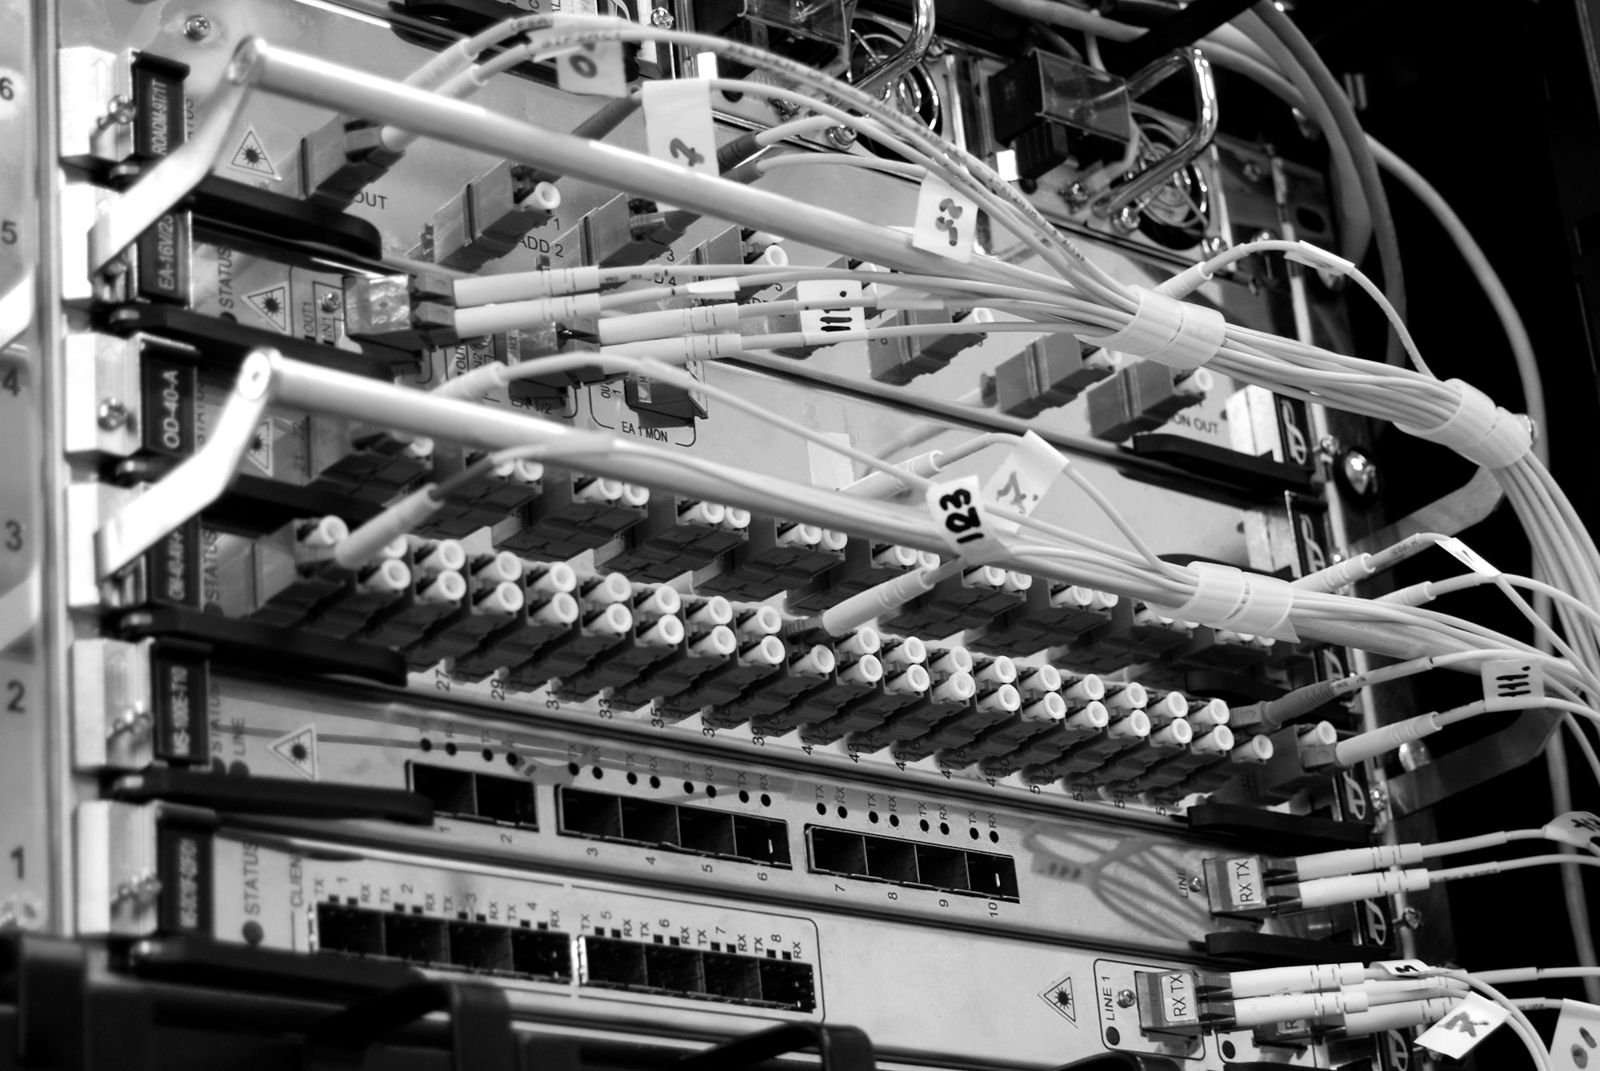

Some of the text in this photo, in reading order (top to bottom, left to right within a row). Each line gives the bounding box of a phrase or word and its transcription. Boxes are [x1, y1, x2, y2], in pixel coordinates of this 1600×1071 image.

[2, 220, 18, 245] 5
[553, 218, 560, 231] 1
[554, 243, 564, 258] 2
[217, 246, 234, 309] STATUS
[2, 367, 21, 397] 4
[163, 369, 180, 449] OD-40-A
[622, 421, 637, 435] EA
[645, 428, 669, 443] MON
[939, 487, 984, 545] 123
[5, 520, 23, 551] 3
[435, 669, 450, 692] 27
[7, 680, 26, 714] 2
[490, 679, 506, 701] 29
[546, 690, 560, 711] 31
[598, 698, 613, 720] 33
[651, 707, 665, 729] 35
[701, 716, 716, 738] 37
[752, 725, 765, 747] 39
[737, 770, 748, 786] TX
[760, 774, 769, 791] RX
[815, 784, 825, 801] TX
[836, 786, 846, 804] RX
[867, 793, 877, 809] TX
[888, 795, 898, 812] RX
[918, 802, 928, 817] TX
[938, 804, 948, 820] RX
[968, 810, 977, 825] TX
[988, 813, 998, 829] RX
[500, 833, 513, 845] 2
[586, 846, 600, 858] 3
[645, 855, 657, 866] 4
[11, 845, 24, 880] 1
[701, 863, 714, 874] 5
[243, 843, 260, 917] STATUS
[336, 876, 348, 884] 1
[757, 872, 769, 882] 6
[1177, 867, 1189, 898] LINE
[1235, 861, 1253, 902] RX TX
[314, 878, 325, 895] TX
[361, 884, 371, 903] RX
[401, 883, 414, 895] 2
[834, 883, 846, 893] 7
[380, 887, 391, 904] TX
[425, 892, 435, 912] RX
[443, 896, 454, 912] TX
[465, 892, 477, 903] 3
[887, 891, 899, 901] 8
[939, 898, 950, 908] 9
[489, 901, 499, 920] RX
[507, 905, 517, 921] TX
[525, 901, 537, 911] 4
[988, 902, 999, 918] 10
[551, 909, 560, 928] RX
[581, 913, 591, 930] TX
[601, 910, 613, 920] 5
[658, 918, 670, 928] 6
[623, 919, 633, 937] RX
[640, 922, 650, 938] TX
[681, 926, 691, 945] RX
[715, 925, 726, 935] 7
[698, 929, 708, 945] TX
[738, 934, 747, 952] RX
[754, 937, 764, 953] TX
[771, 934, 782, 943] 8
[793, 941, 802, 959] RX
[1170, 974, 1187, 1017] RX TX
[1104, 989, 1116, 1021] LINE
